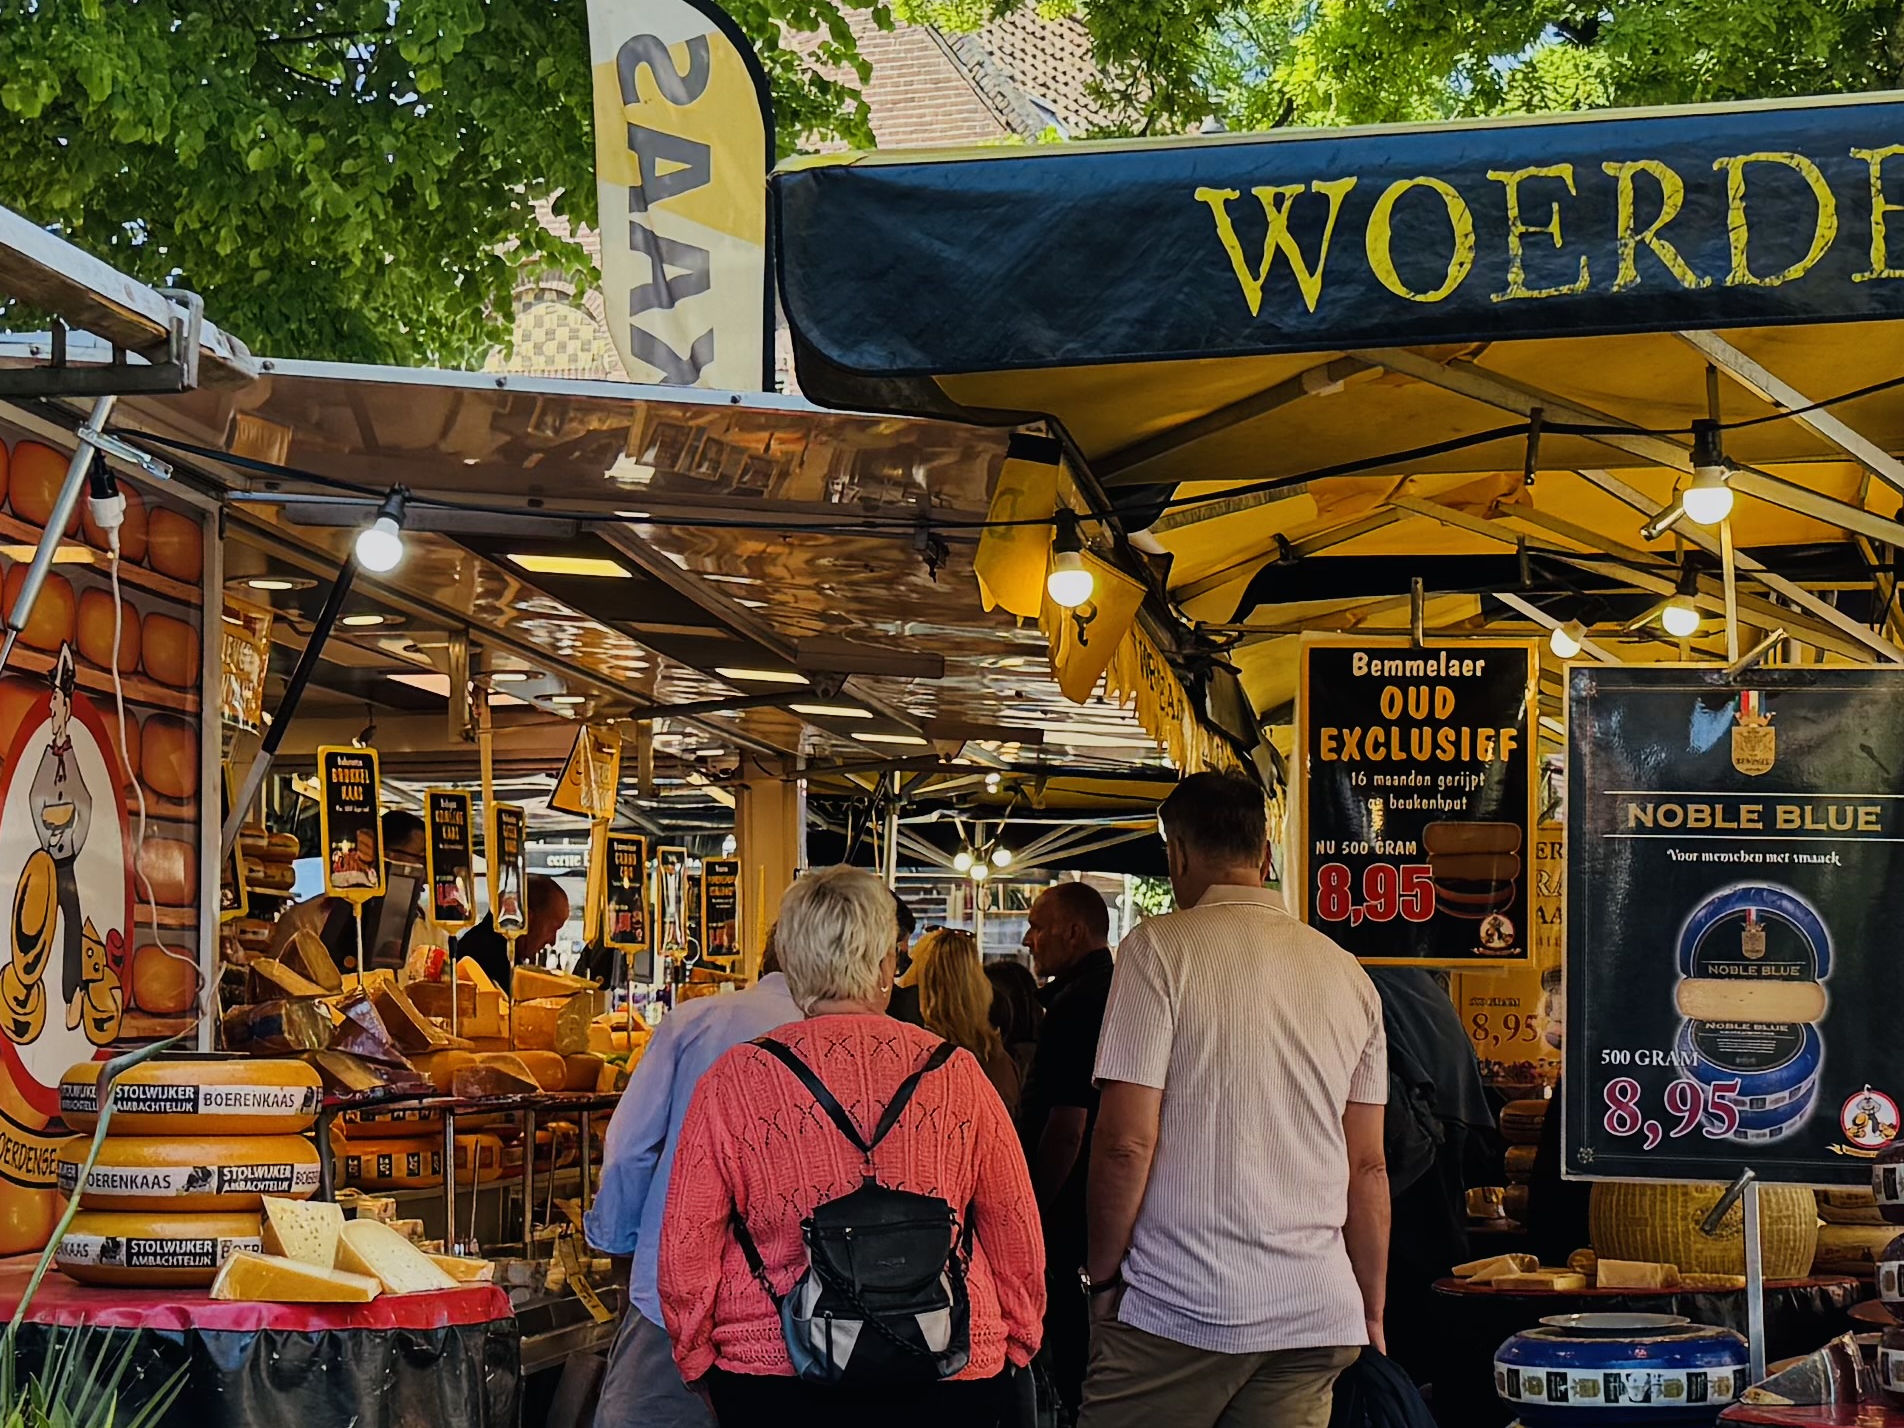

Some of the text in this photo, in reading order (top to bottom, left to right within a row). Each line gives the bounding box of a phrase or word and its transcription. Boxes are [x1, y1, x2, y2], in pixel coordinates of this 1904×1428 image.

[1352, 650, 1485, 677] Bemmelaer
[1379, 685, 1456, 720] OUD
[1319, 725, 1518, 763] EXCLUSIEF
[1350, 771, 1367, 786] 16
[1437, 771, 1486, 792] gerijpt
[1389, 794, 1468, 812] beukenhout
[1627, 802, 1882, 832] NOBLE BLUE
[1315, 839, 1417, 855] NU 500 GRAM
[1316, 862, 1436, 928] 8,95
[1708, 964, 1801, 976] NOBLE BLUE
[1472, 1012, 1539, 1047] 8,95
[1600, 1048, 1699, 1067] 500 GRAM
[116, 1085, 195, 1100] STOLWIJKER
[203, 1091, 295, 1108] BOERENKAAS
[1602, 1077, 1742, 1150] 8,95
[87, 1174, 171, 1190] OERENKAAS
[222, 1164, 292, 1181] STOLWIJKER
[130, 1239, 213, 1254] STOLWIJKER
